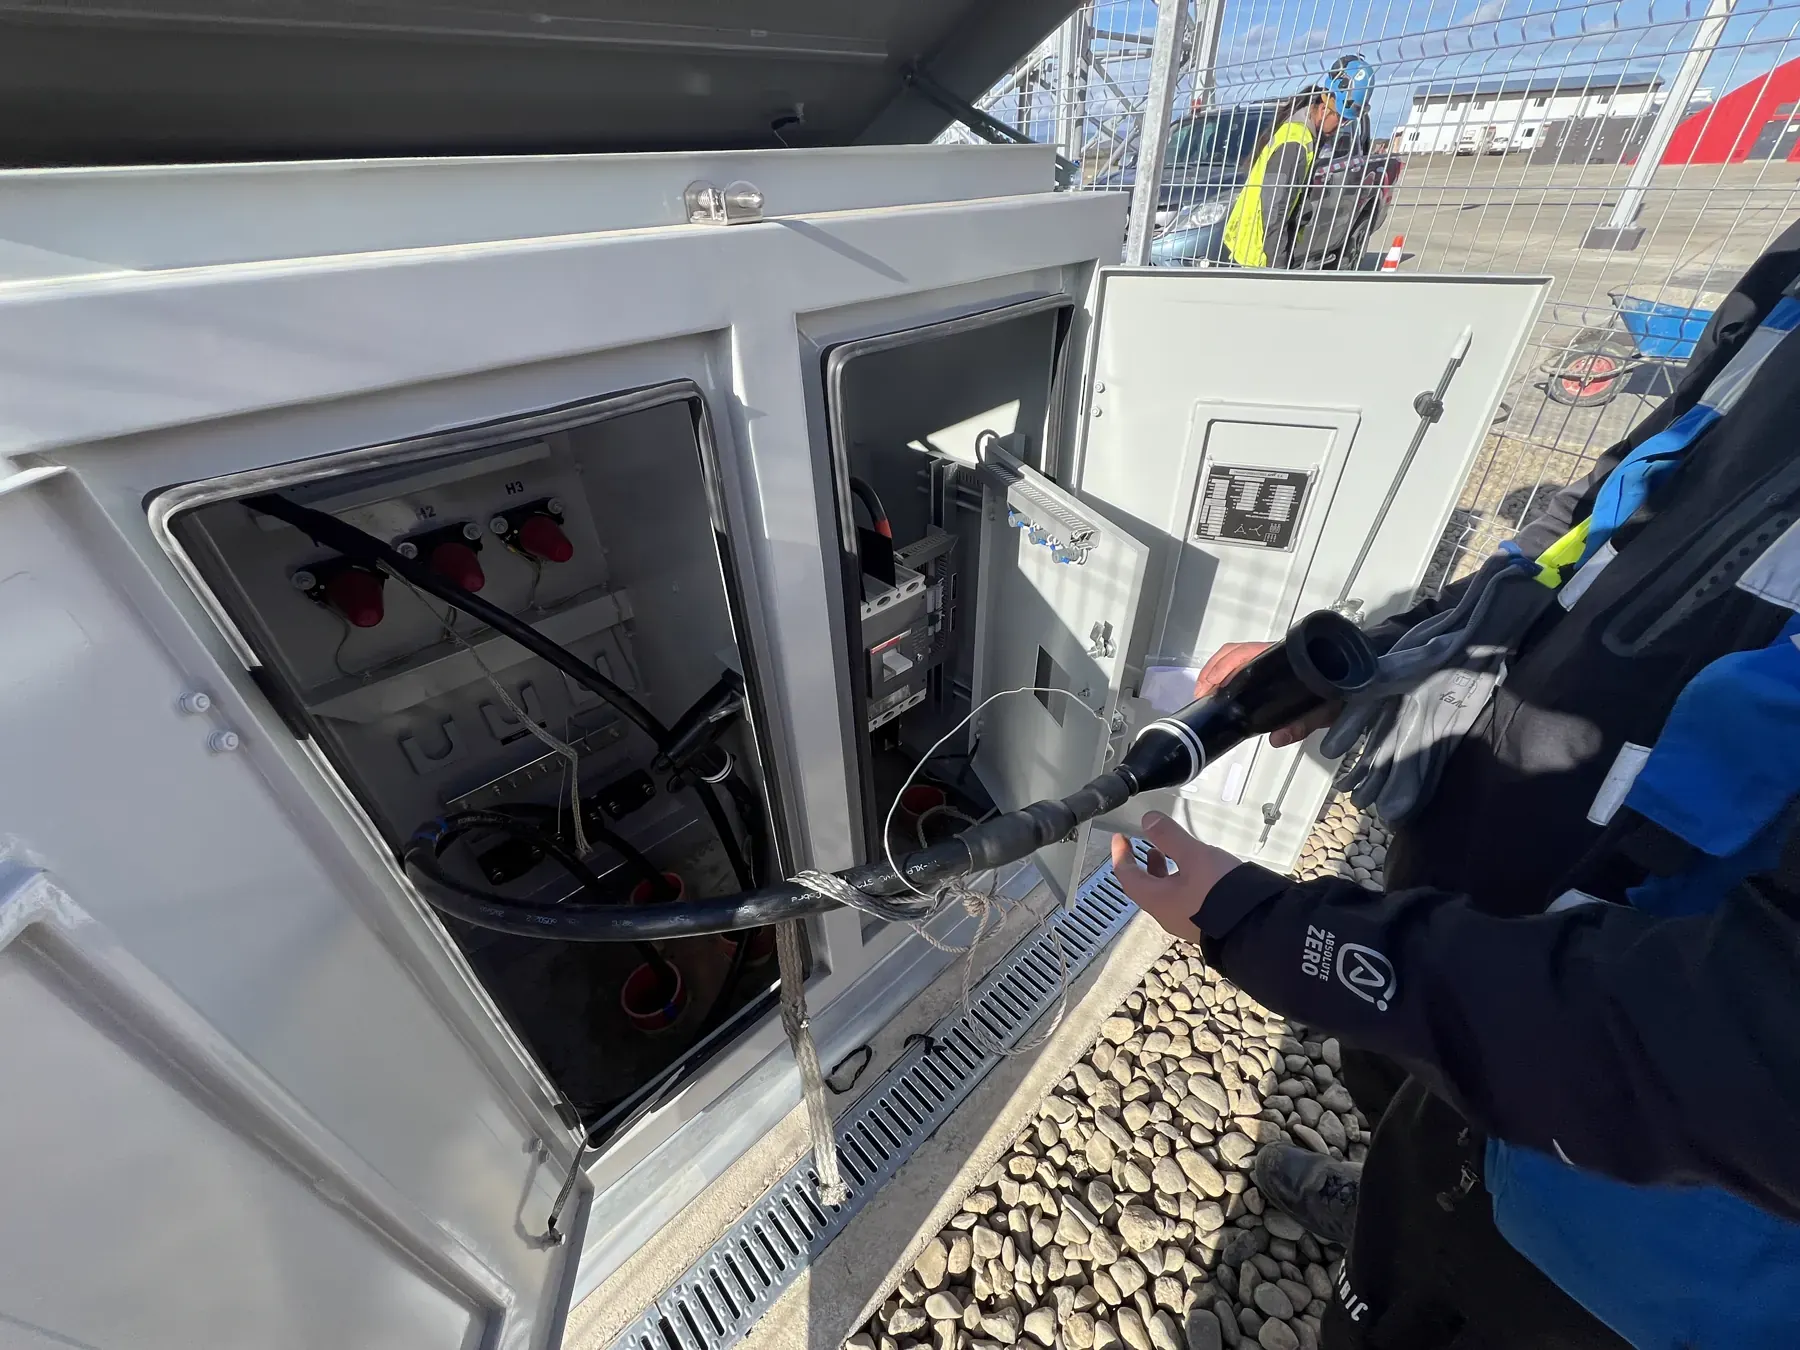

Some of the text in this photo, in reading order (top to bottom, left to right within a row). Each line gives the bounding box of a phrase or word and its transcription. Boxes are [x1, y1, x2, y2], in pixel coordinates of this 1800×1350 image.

[505, 481, 524, 495] H3
[1301, 924, 1326, 976] ZERO
[1320, 931, 1336, 981] ABSOLUTE
